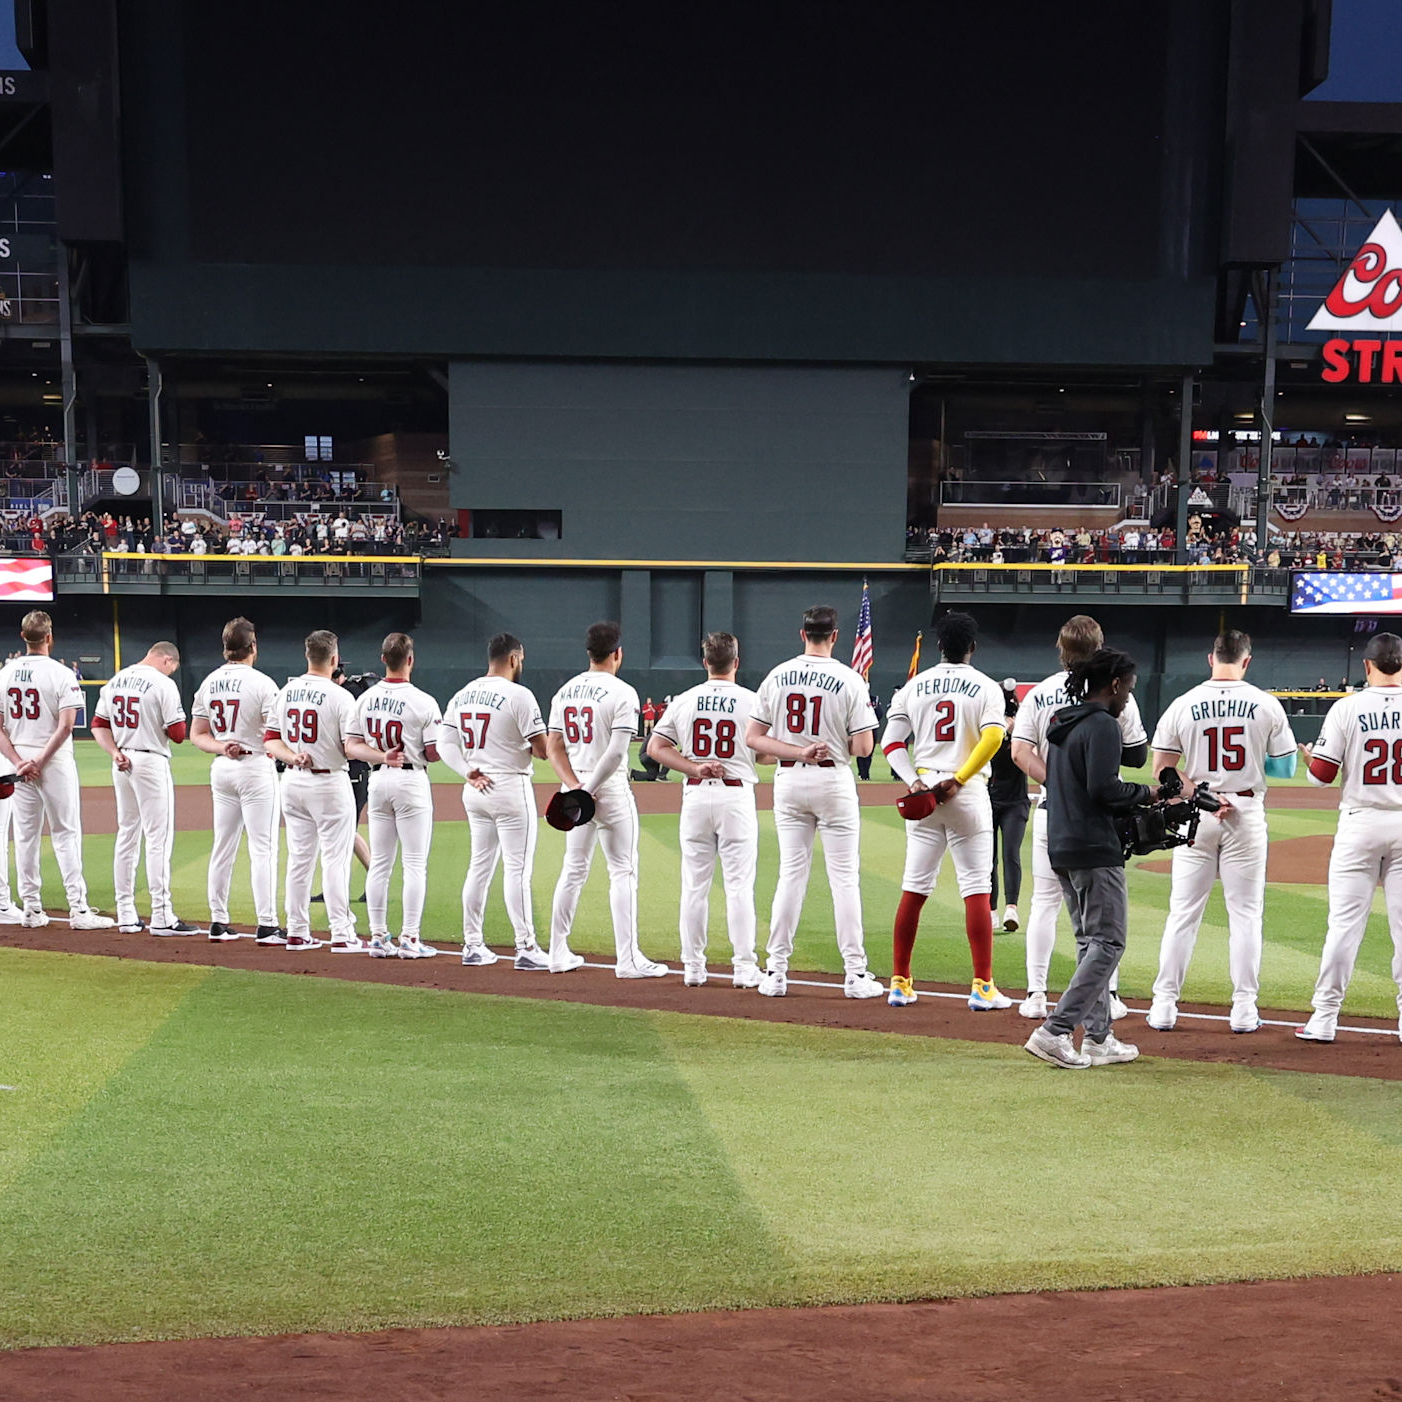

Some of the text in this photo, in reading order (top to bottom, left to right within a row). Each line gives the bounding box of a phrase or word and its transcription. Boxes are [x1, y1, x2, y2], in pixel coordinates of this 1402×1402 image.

[14, 670, 33, 684] PUK
[209, 680, 242, 695] GINKEL
[773, 669, 846, 695] THOMPSON
[915, 679, 982, 699] PERDOMO
[7, 687, 40, 720] 33
[112, 695, 140, 729] 35
[286, 688, 327, 706] BURNES
[367, 695, 406, 715] JARVIS
[454, 694, 507, 712] RODRIGUEZ
[560, 687, 610, 704] MARTINEZ
[697, 695, 738, 714] BEEKS
[1190, 701, 1259, 723] GRICHUK
[210, 699, 240, 733] 37
[286, 708, 319, 744] 39
[563, 706, 595, 744] 63
[785, 692, 824, 736] 81
[934, 700, 956, 742] 2
[366, 717, 404, 753] 40
[460, 712, 491, 750] 57
[692, 718, 736, 759] 68
[1202, 726, 1247, 773] 15
